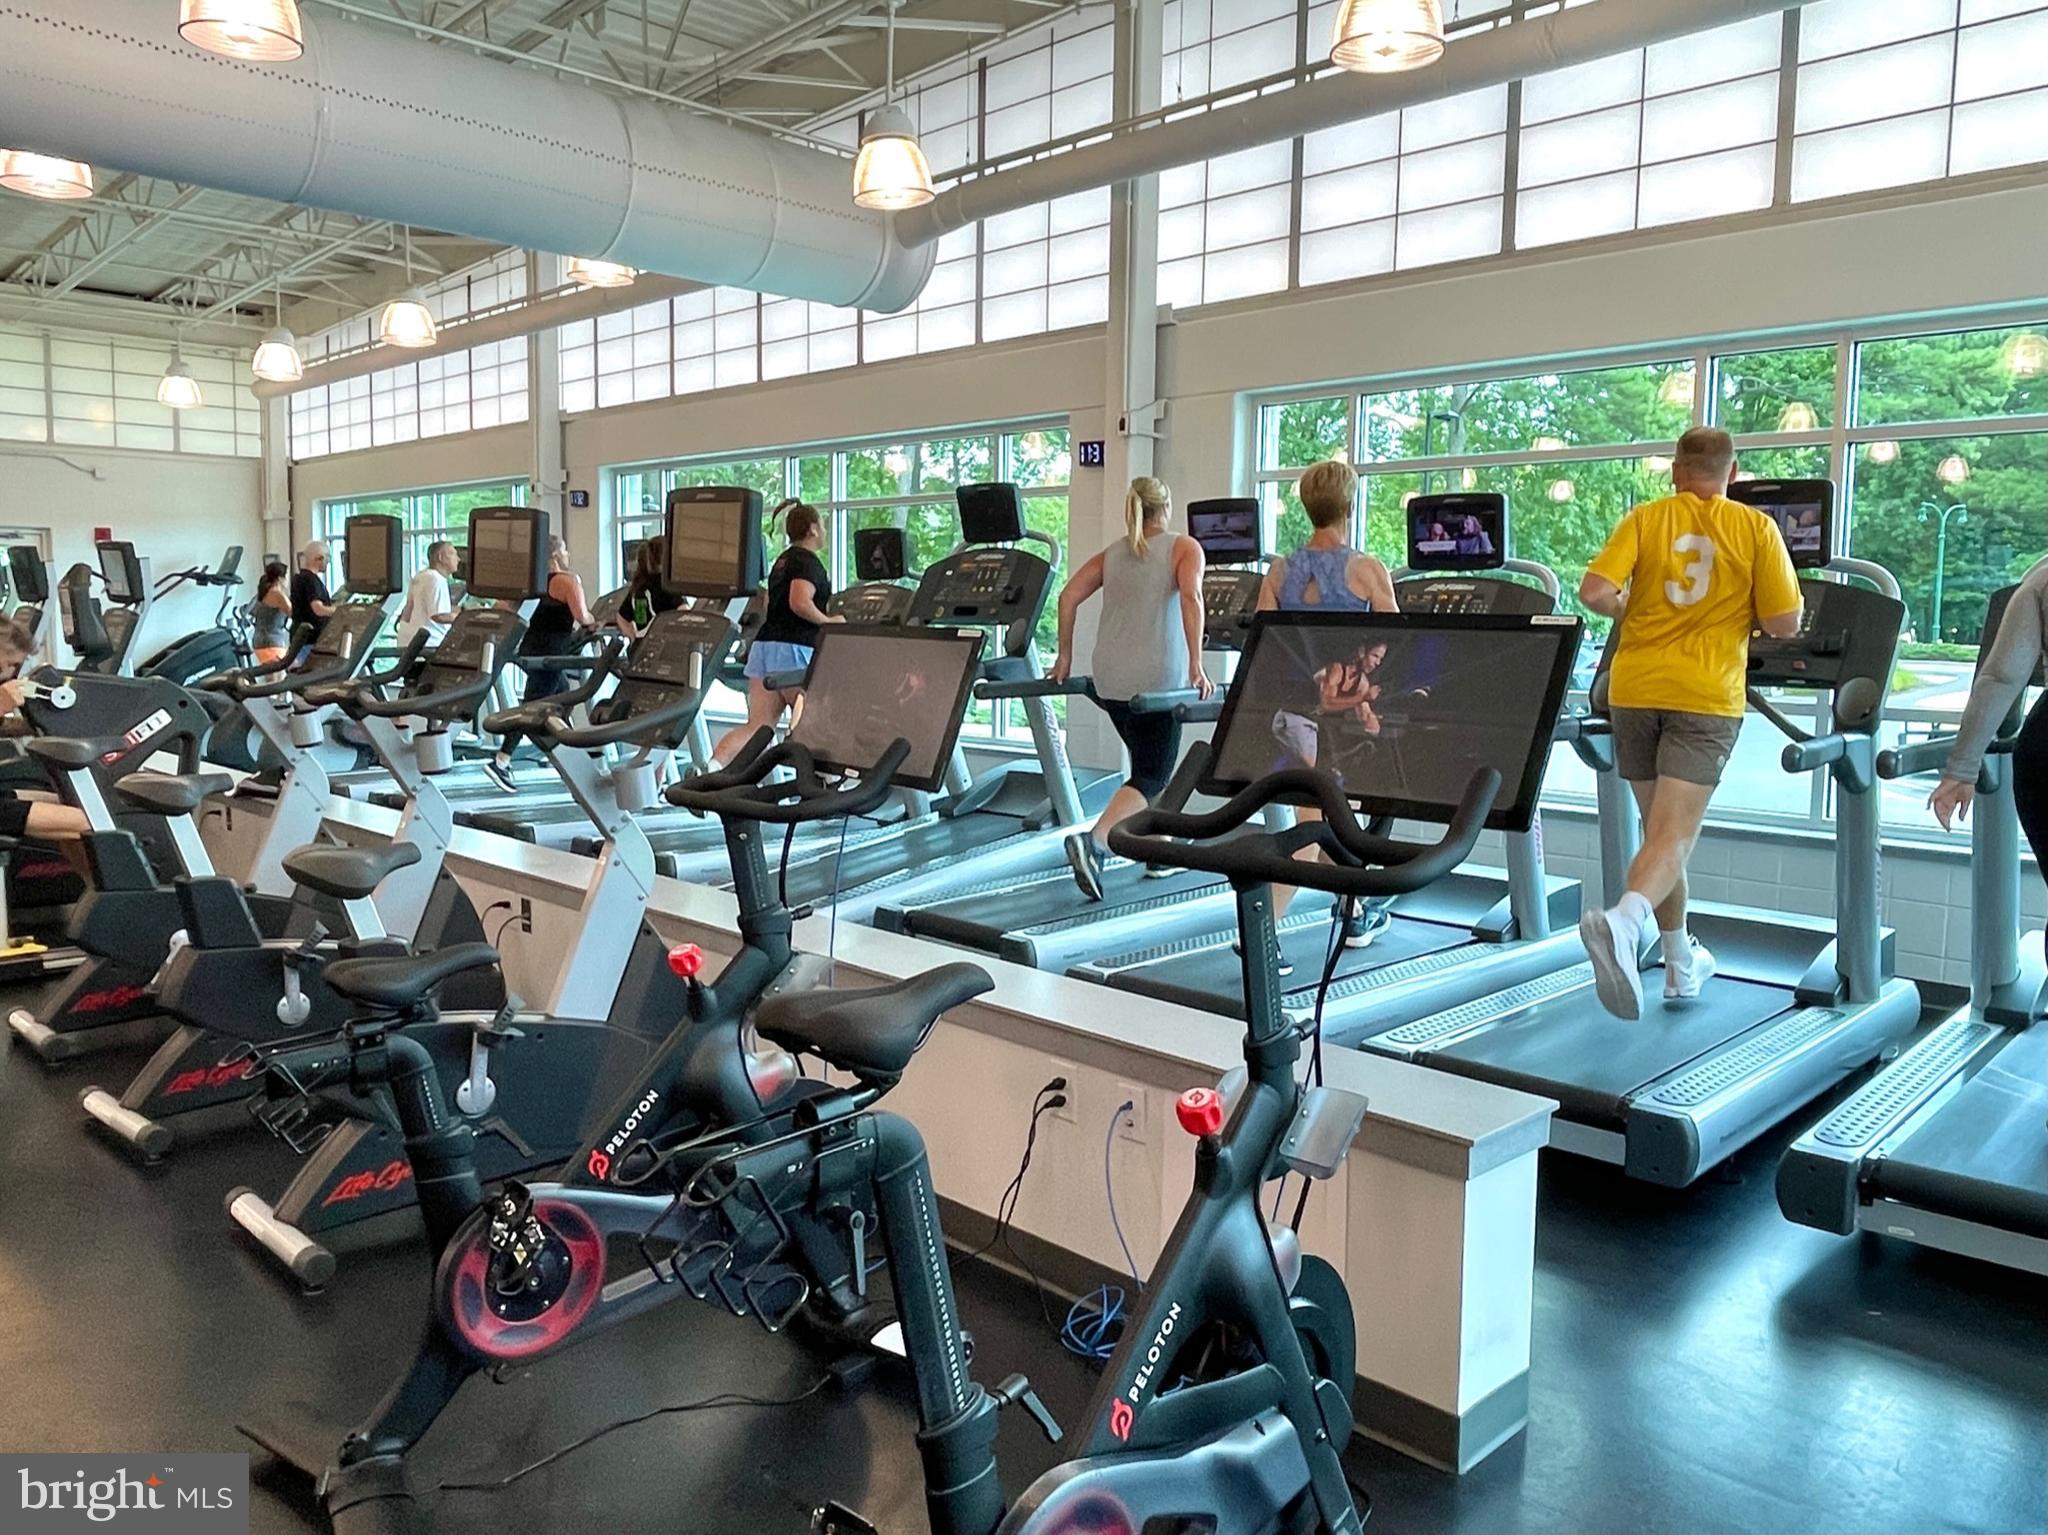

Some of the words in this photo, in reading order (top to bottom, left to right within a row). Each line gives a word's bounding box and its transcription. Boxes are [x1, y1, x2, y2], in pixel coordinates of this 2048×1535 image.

[1664, 532, 1716, 607] 3
[605, 1089, 659, 1155] PELOTON
[1128, 1302, 1181, 1403] PELOTON
